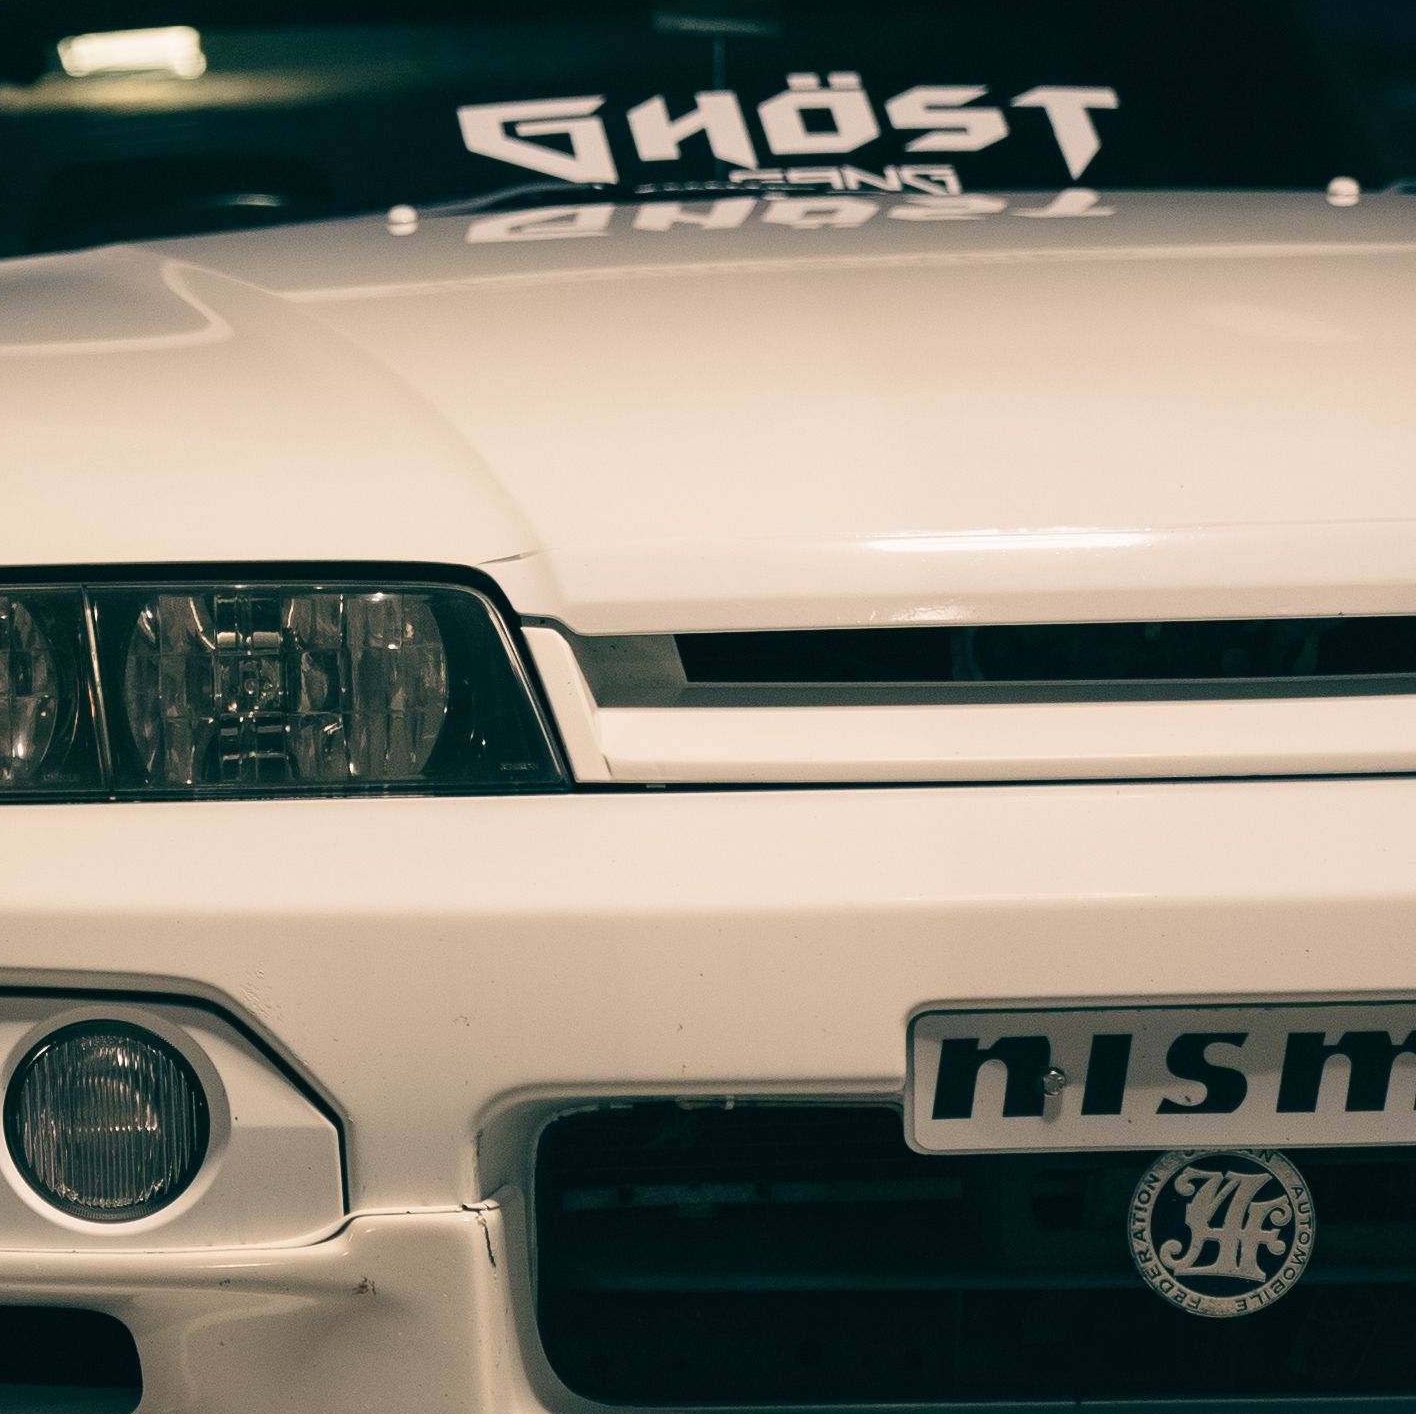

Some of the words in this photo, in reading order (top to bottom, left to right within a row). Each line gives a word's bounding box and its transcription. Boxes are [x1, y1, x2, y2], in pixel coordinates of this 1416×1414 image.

[456, 70, 1120, 185] GHÖST
[1132, 1173, 1202, 1311] FEDERATION
[1235, 1185, 1312, 1312] AUTOMOBILE
